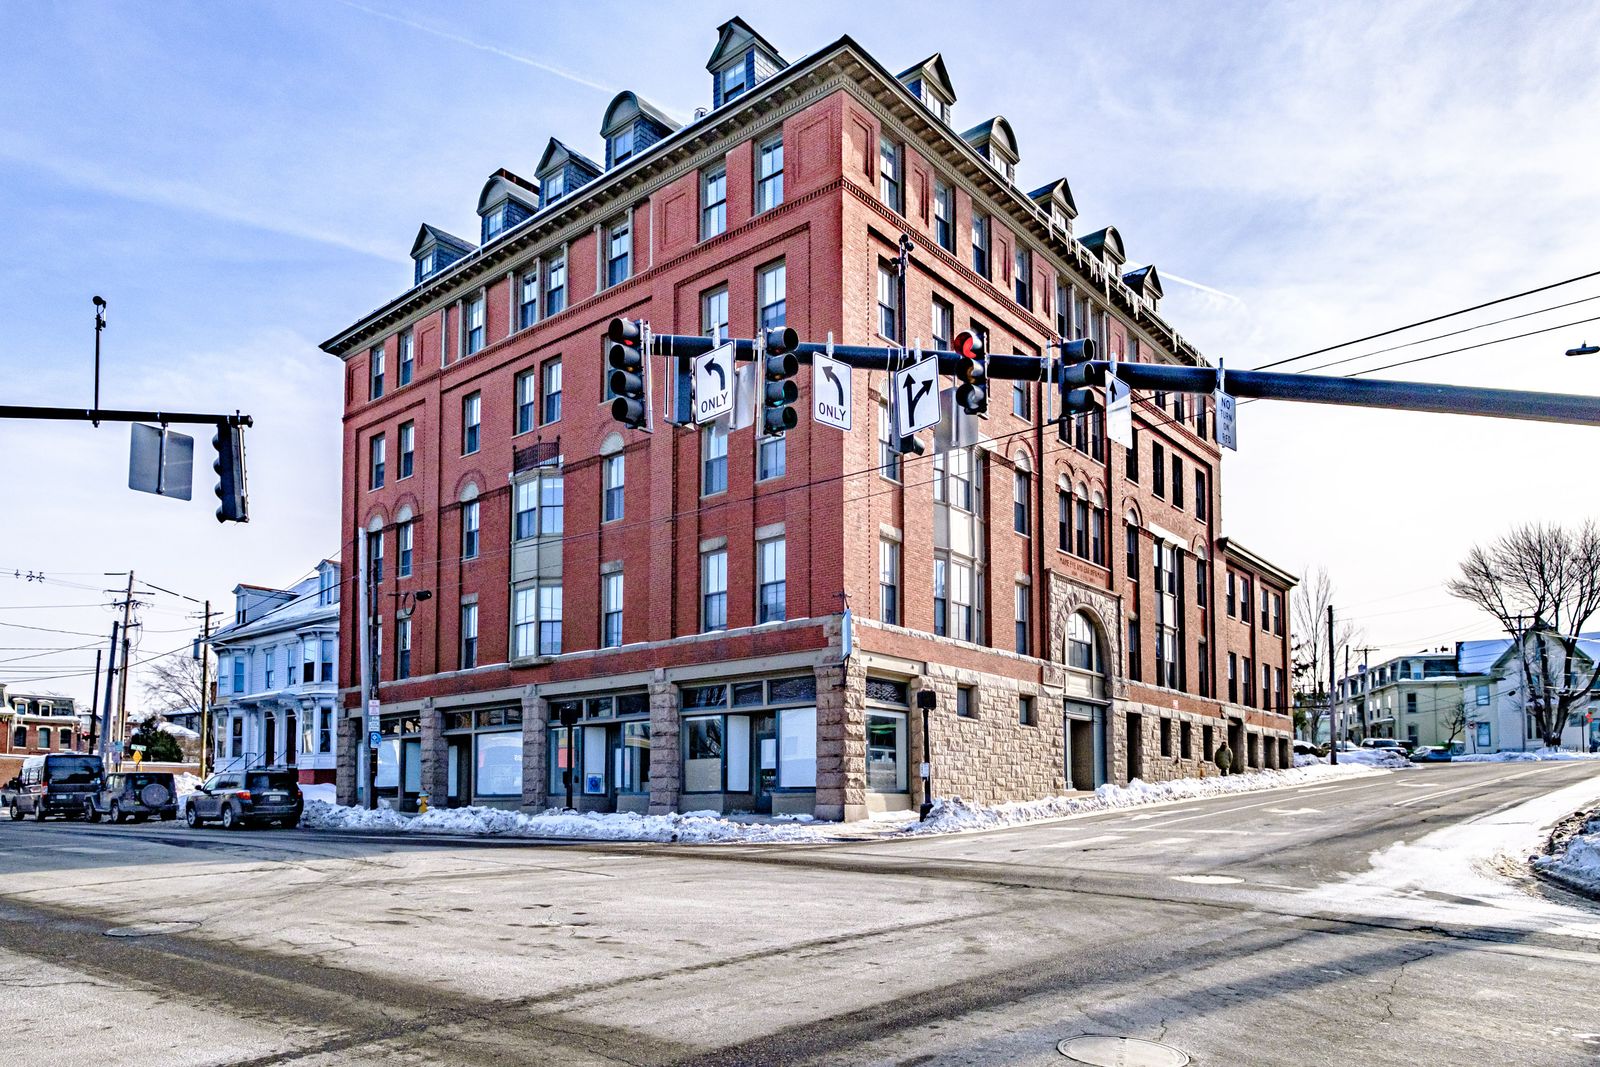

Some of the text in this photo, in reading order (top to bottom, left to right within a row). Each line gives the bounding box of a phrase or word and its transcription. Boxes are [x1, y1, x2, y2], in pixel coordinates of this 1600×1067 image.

[701, 392, 728, 414] ONLY
[1221, 397, 1230, 409] NO
[818, 402, 847, 422] ONLY
[1220, 409, 1233, 422] TURN
[1223, 423, 1230, 431] ON
[1222, 432, 1231, 444] RED
